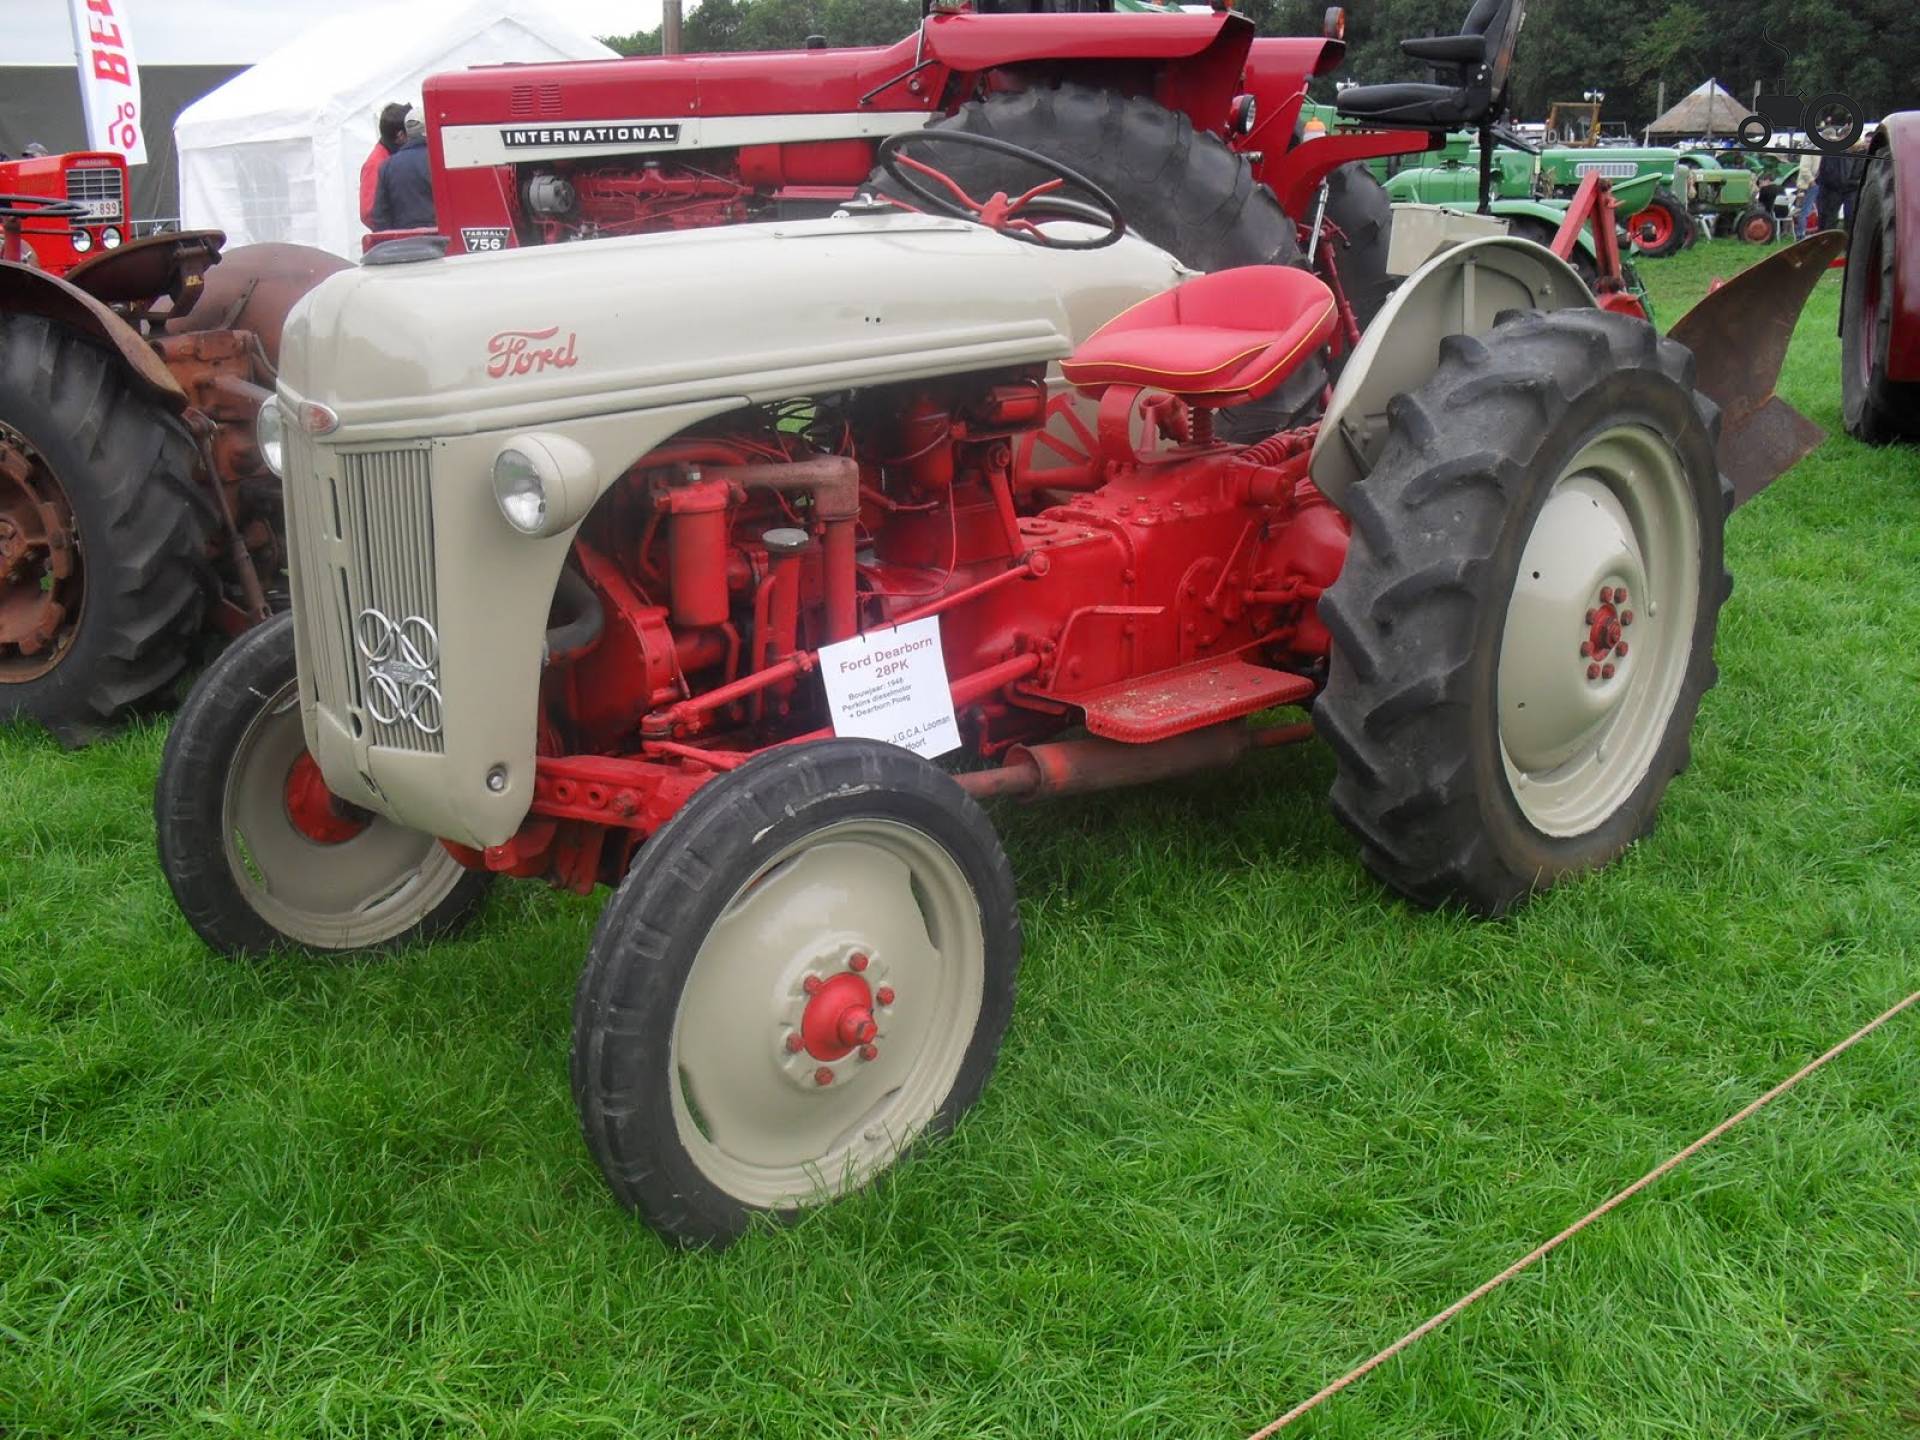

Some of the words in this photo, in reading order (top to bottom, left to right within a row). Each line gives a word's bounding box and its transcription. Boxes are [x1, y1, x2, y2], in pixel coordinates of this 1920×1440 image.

[506, 127, 674, 144] INTERNATIONAL
[470, 238, 501, 250] 756
[487, 326, 578, 379] Ford
[840, 655, 872, 674] Ford
[874, 637, 933, 663] Dearborn
[875, 658, 910, 679] 28PK
